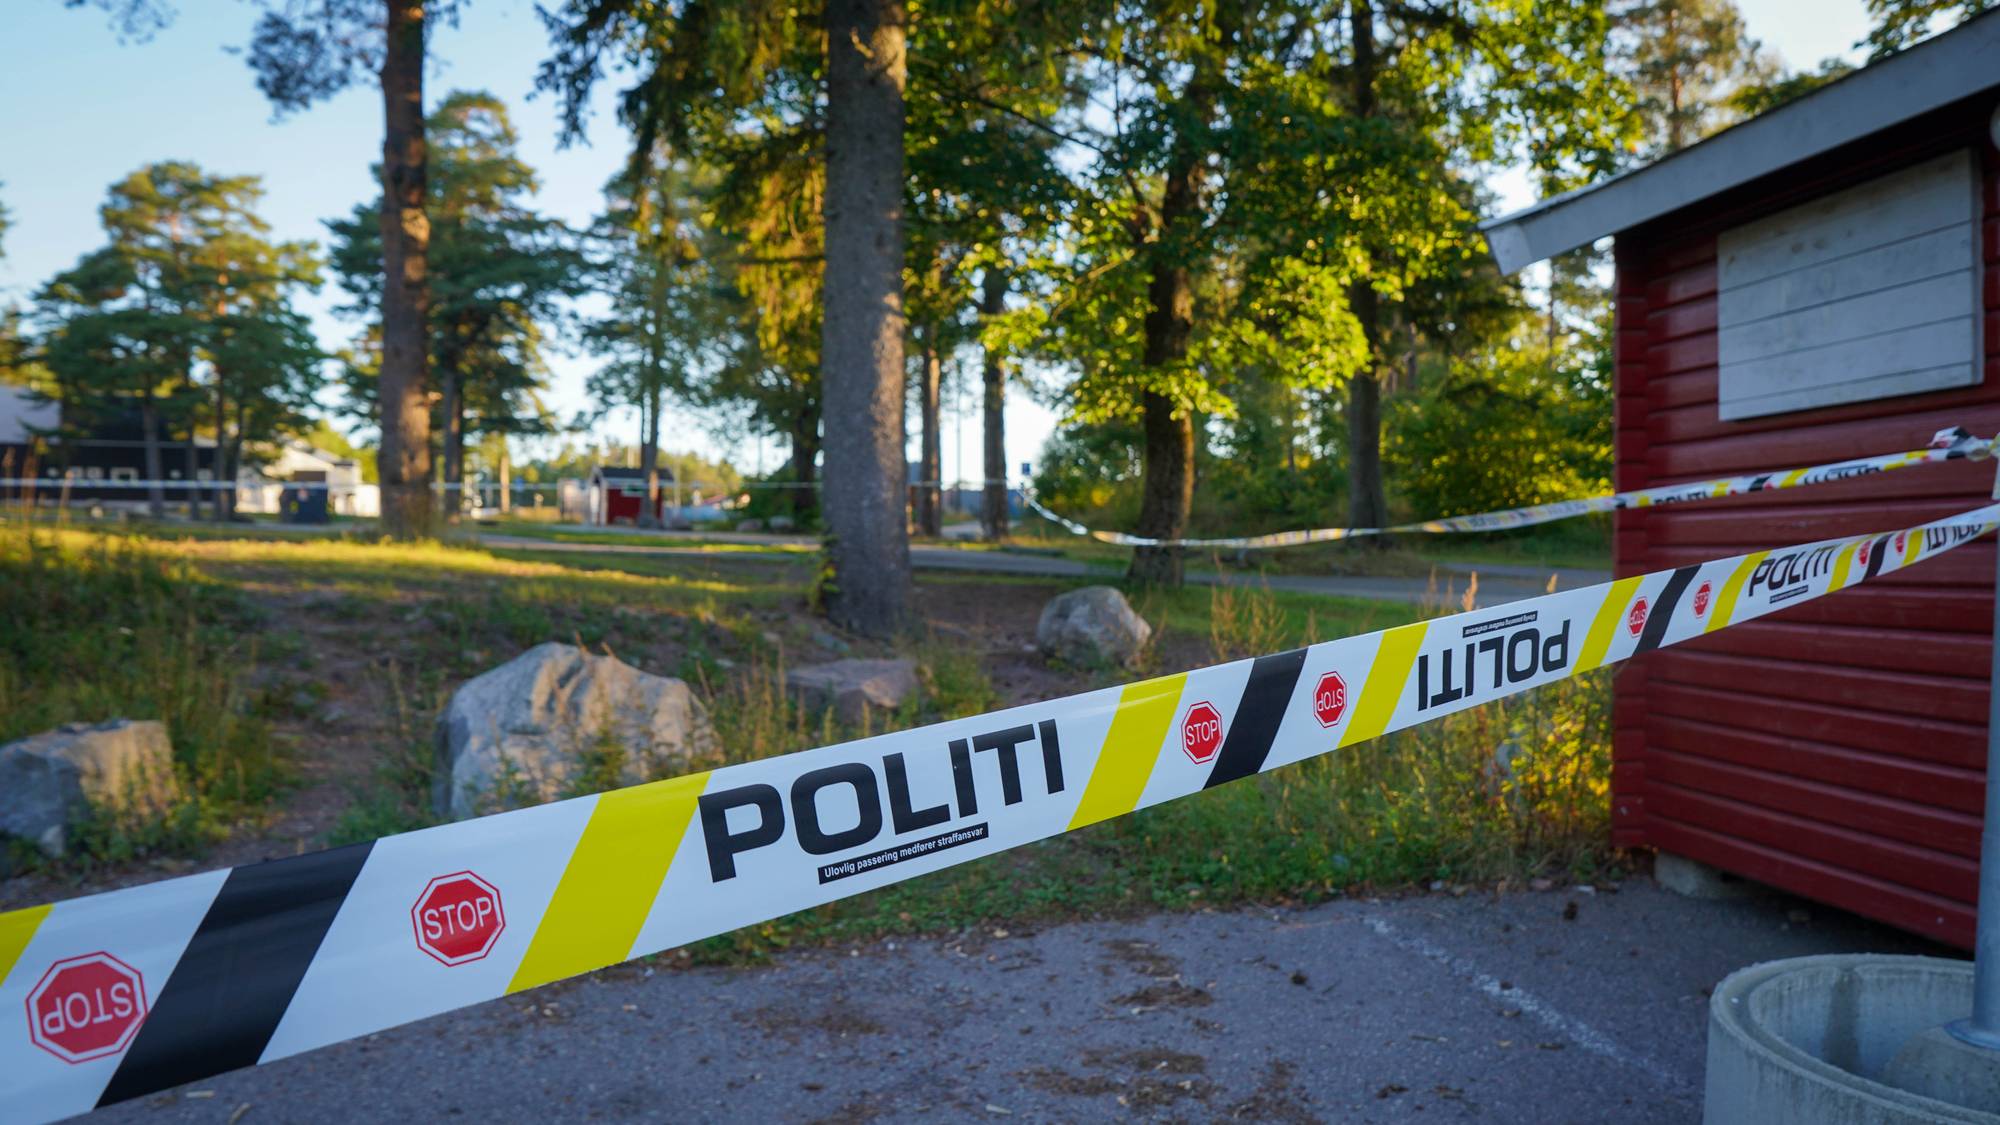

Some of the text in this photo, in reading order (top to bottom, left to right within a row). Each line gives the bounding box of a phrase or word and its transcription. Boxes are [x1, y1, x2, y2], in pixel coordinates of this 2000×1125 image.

[1748, 544, 1836, 597] POLITI
[1417, 619, 1571, 712] POLITI
[1317, 688, 1344, 712] STOP
[1185, 719, 1218, 746] STOP
[697, 718, 1065, 883] POLITI
[824, 827, 984, 878] Ulovlig passering medfører straffansvar
[424, 896, 492, 940] STOP
[43, 982, 133, 1035] STOP
